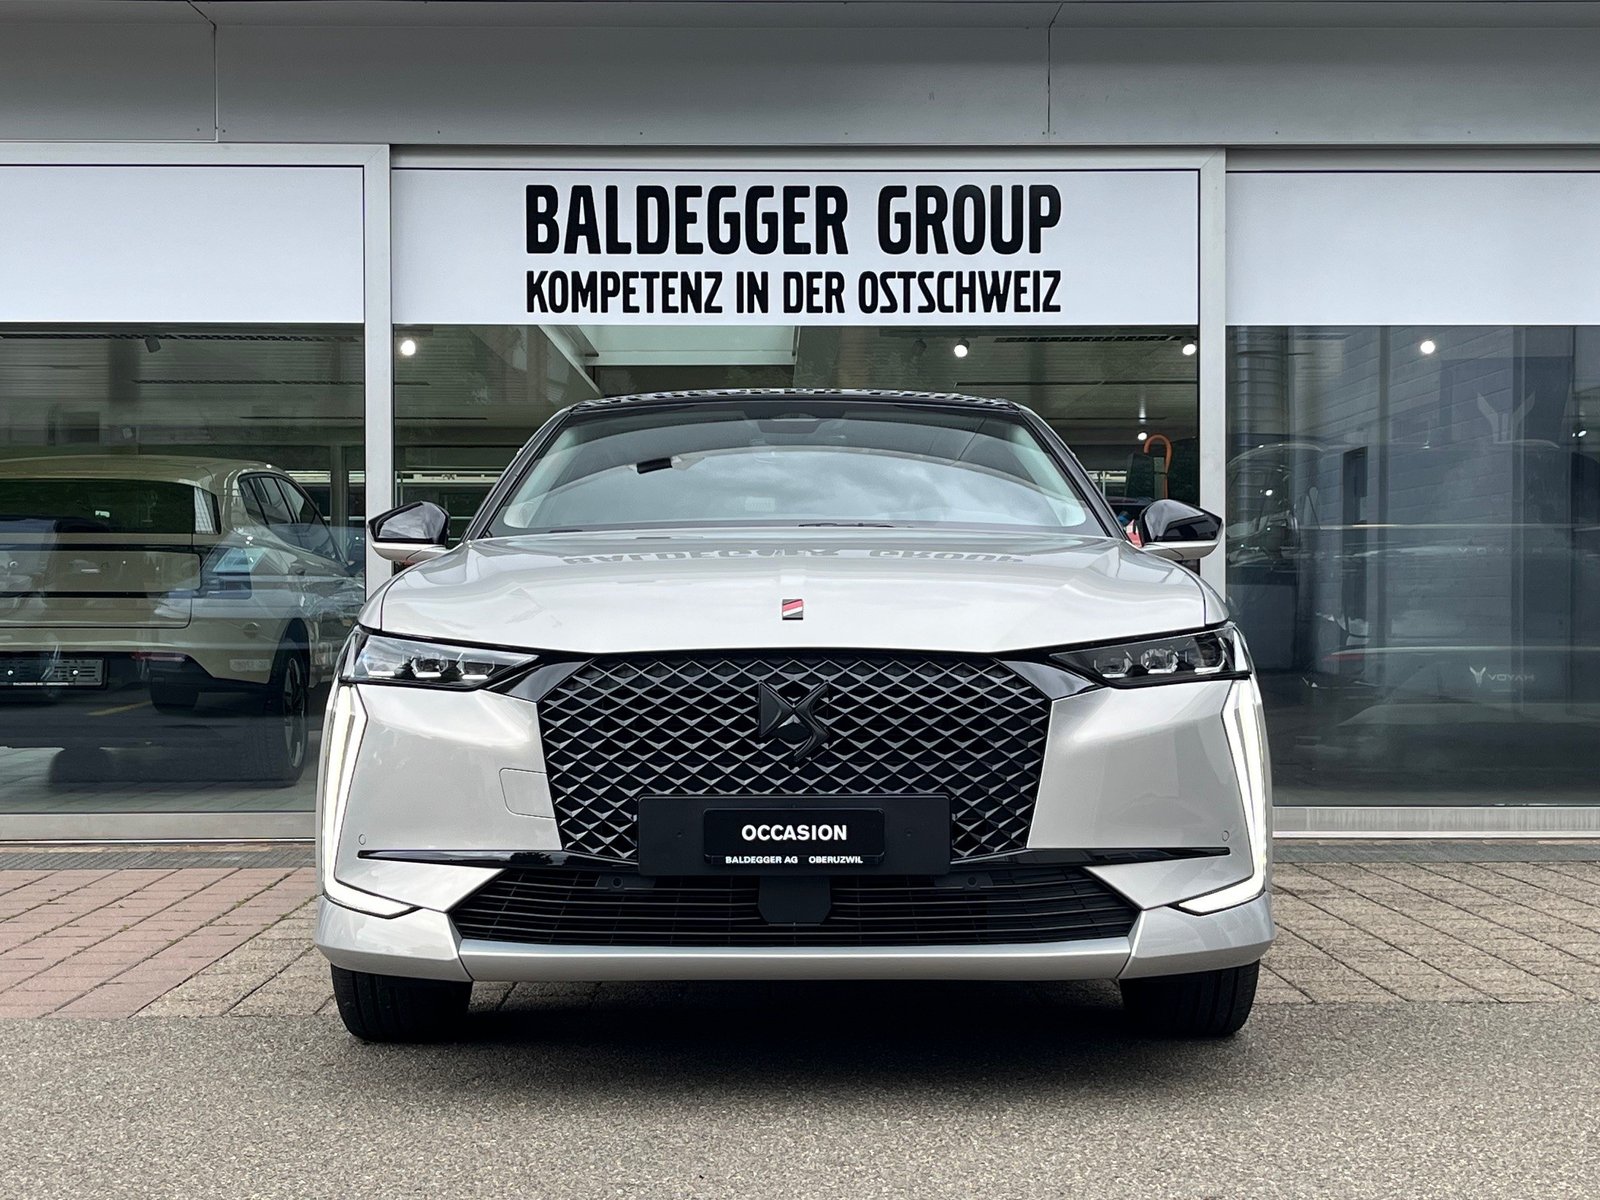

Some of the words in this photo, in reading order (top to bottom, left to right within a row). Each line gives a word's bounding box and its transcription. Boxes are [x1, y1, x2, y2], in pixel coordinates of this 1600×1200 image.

[526, 185, 848, 254] BALDEGGER
[878, 185, 1061, 255] GROUP
[527, 271, 722, 313] KOMPETENZ
[737, 272, 768, 313] IN
[784, 272, 845, 313] DER
[859, 271, 1060, 313] OSTSCHWEIZ
[741, 824, 847, 841] OCCASION
[725, 855, 782, 864] BALDEGGER
[784, 855, 799, 864] AG
[808, 855, 864, 864] OBERUZWIL
